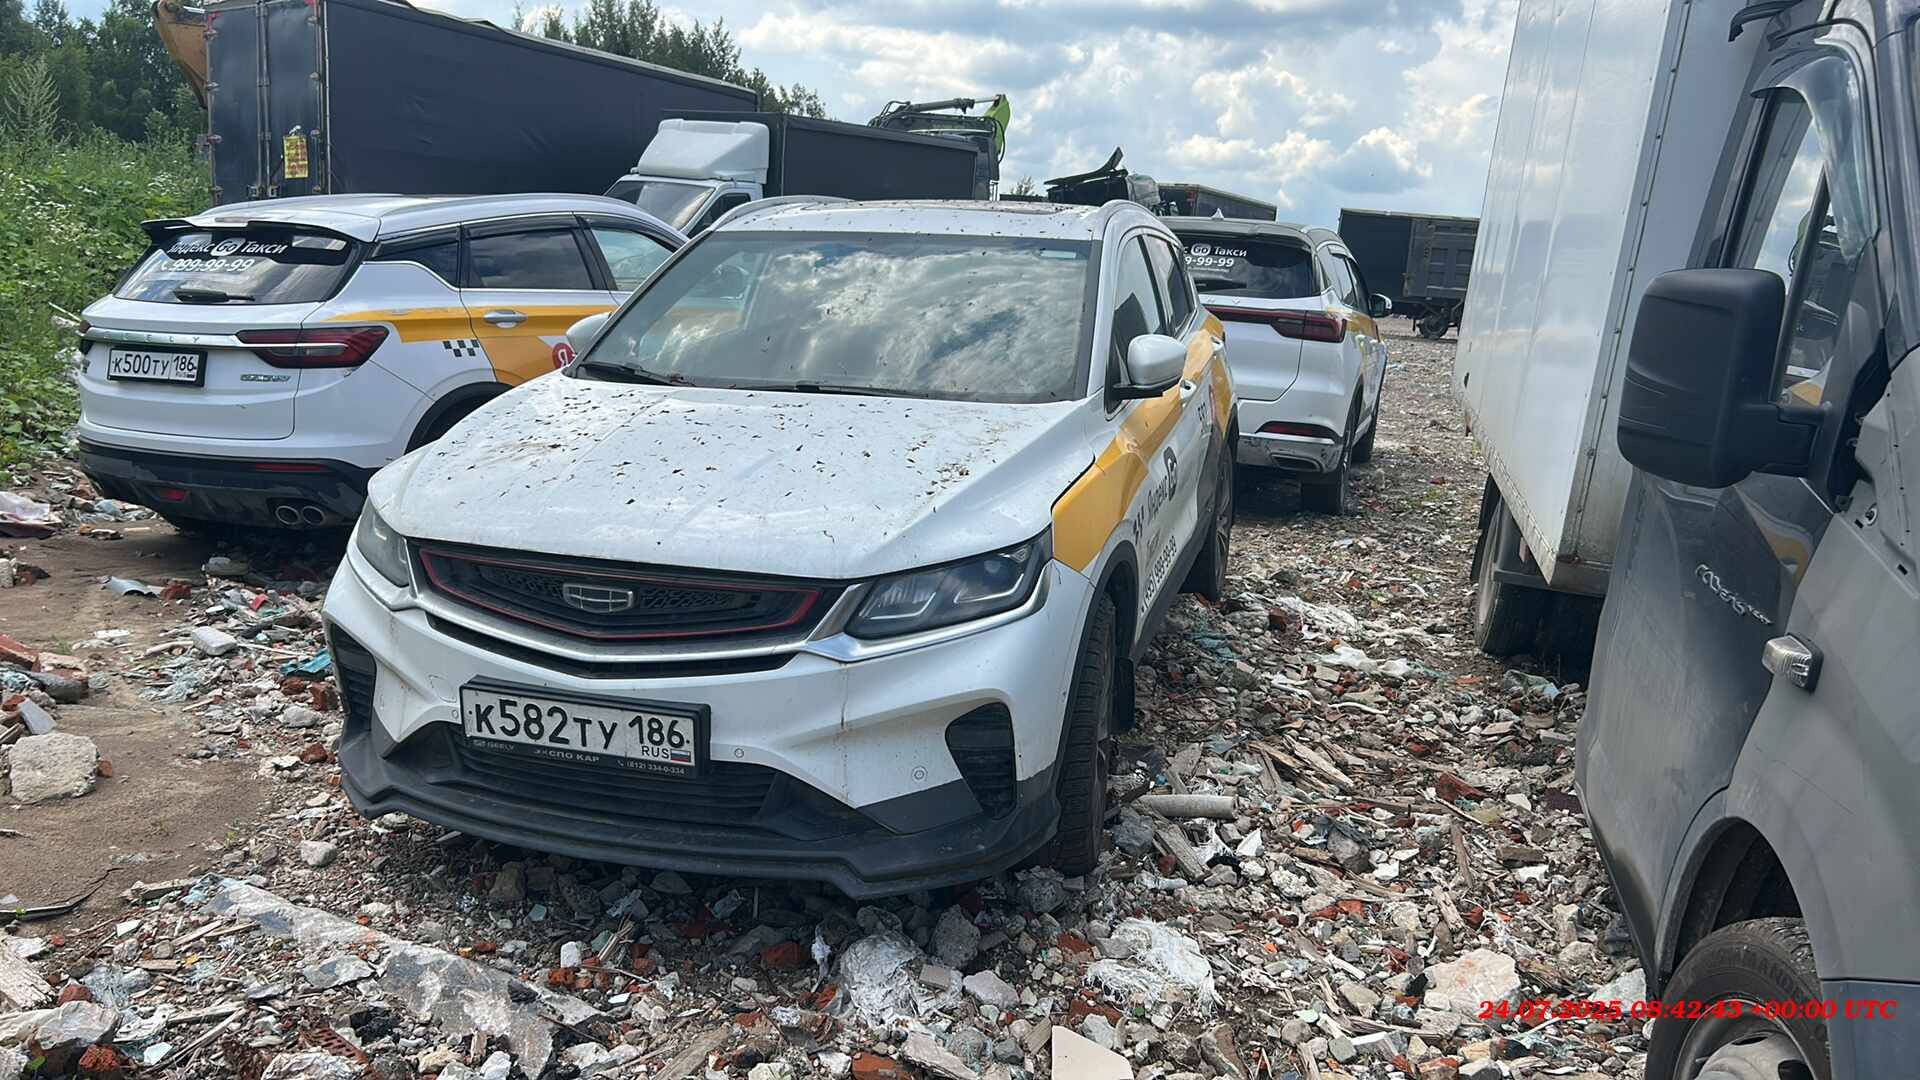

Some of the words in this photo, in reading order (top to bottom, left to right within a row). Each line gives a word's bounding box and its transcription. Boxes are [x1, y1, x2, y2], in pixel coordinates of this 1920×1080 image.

[241, 241, 288, 254] Такси
[1214, 246, 1247, 257] Такси
[172, 259, 254, 272] 999-99-99
[1185, 256, 1234, 267] 9-99-99
[174, 355, 195, 372] 186
[628, 715, 685, 748] 186
[642, 745, 669, 759] RUS
